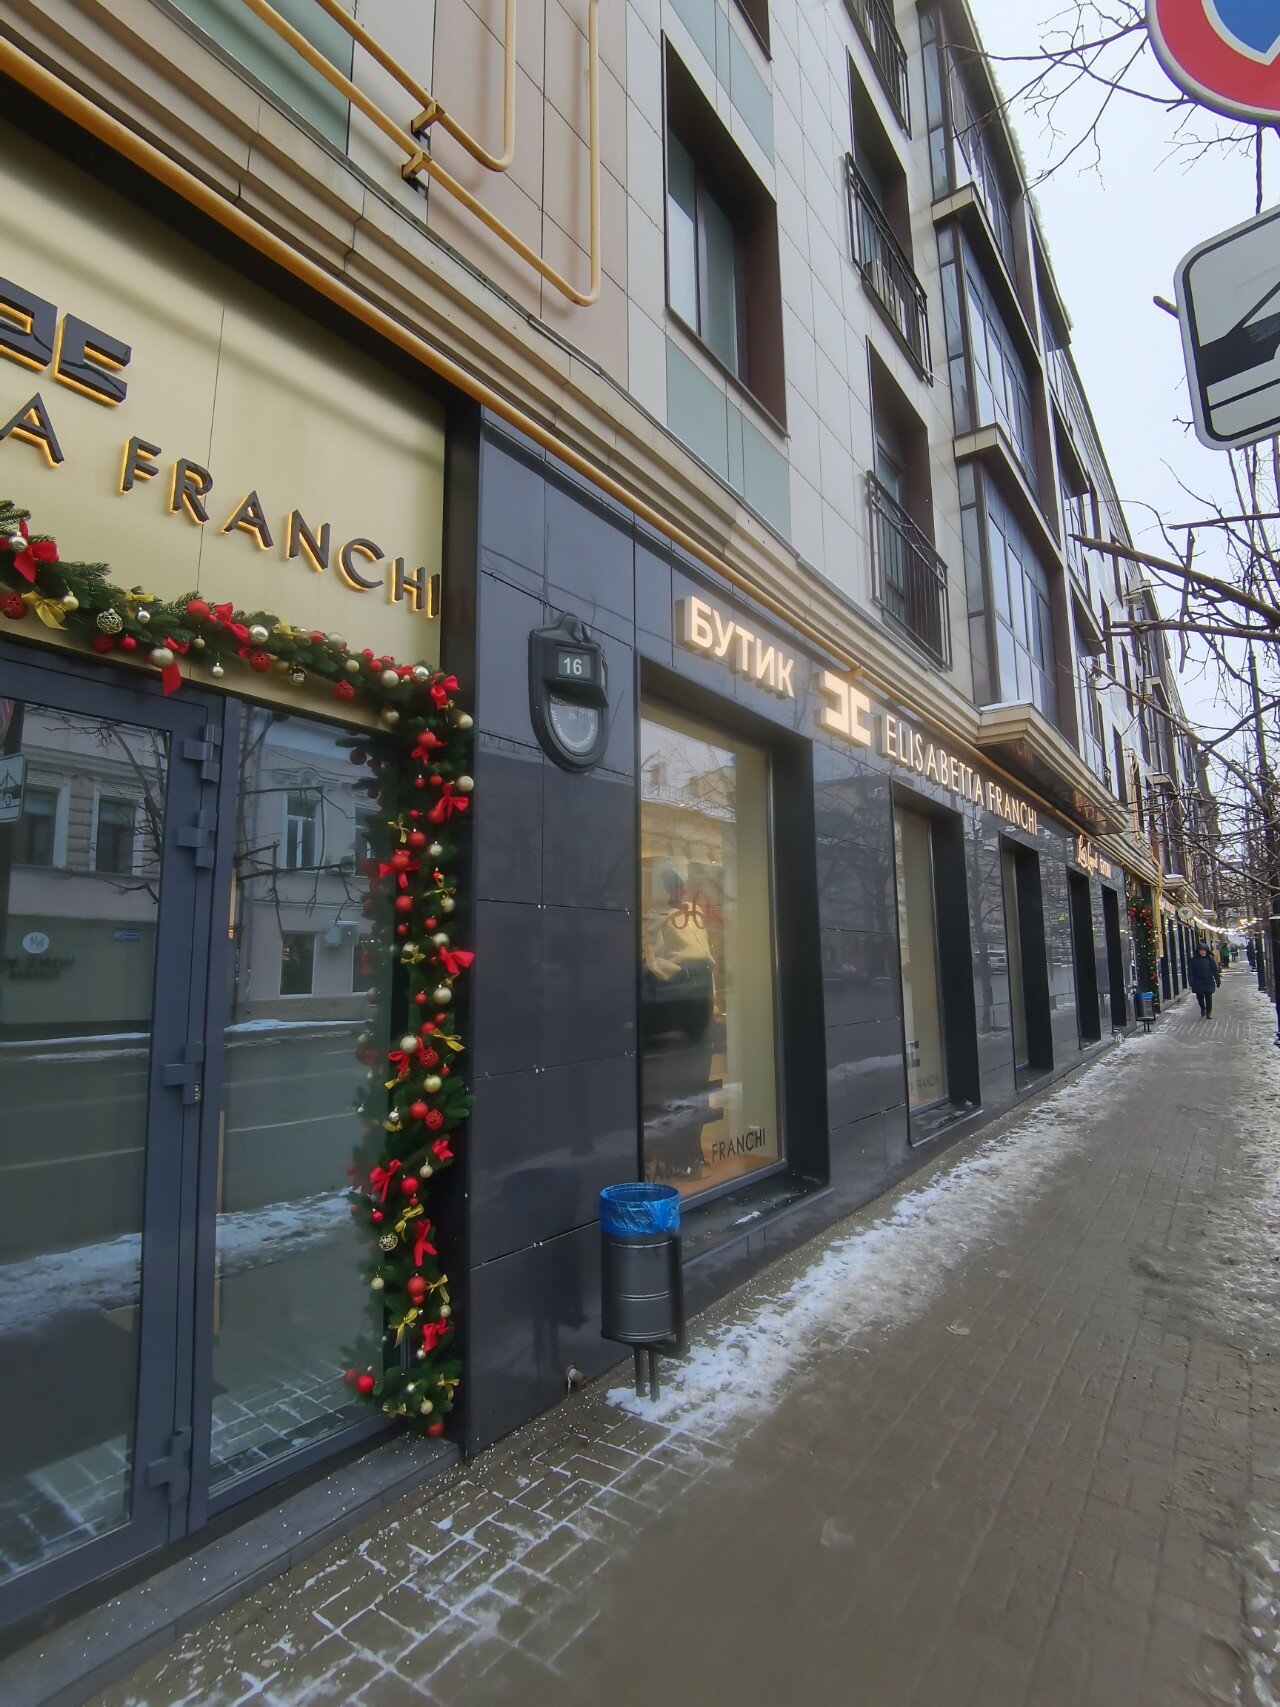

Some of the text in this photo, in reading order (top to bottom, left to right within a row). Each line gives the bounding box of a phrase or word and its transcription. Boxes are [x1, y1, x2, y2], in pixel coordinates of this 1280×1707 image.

[119, 435, 441, 619] FRANCHI
[563, 656, 583, 676] 16
[682, 595, 796, 699] БУТИК
[884, 713, 1039, 837] ELISABETTA FRANCHI
[712, 1127, 766, 1163] FRANCHI
